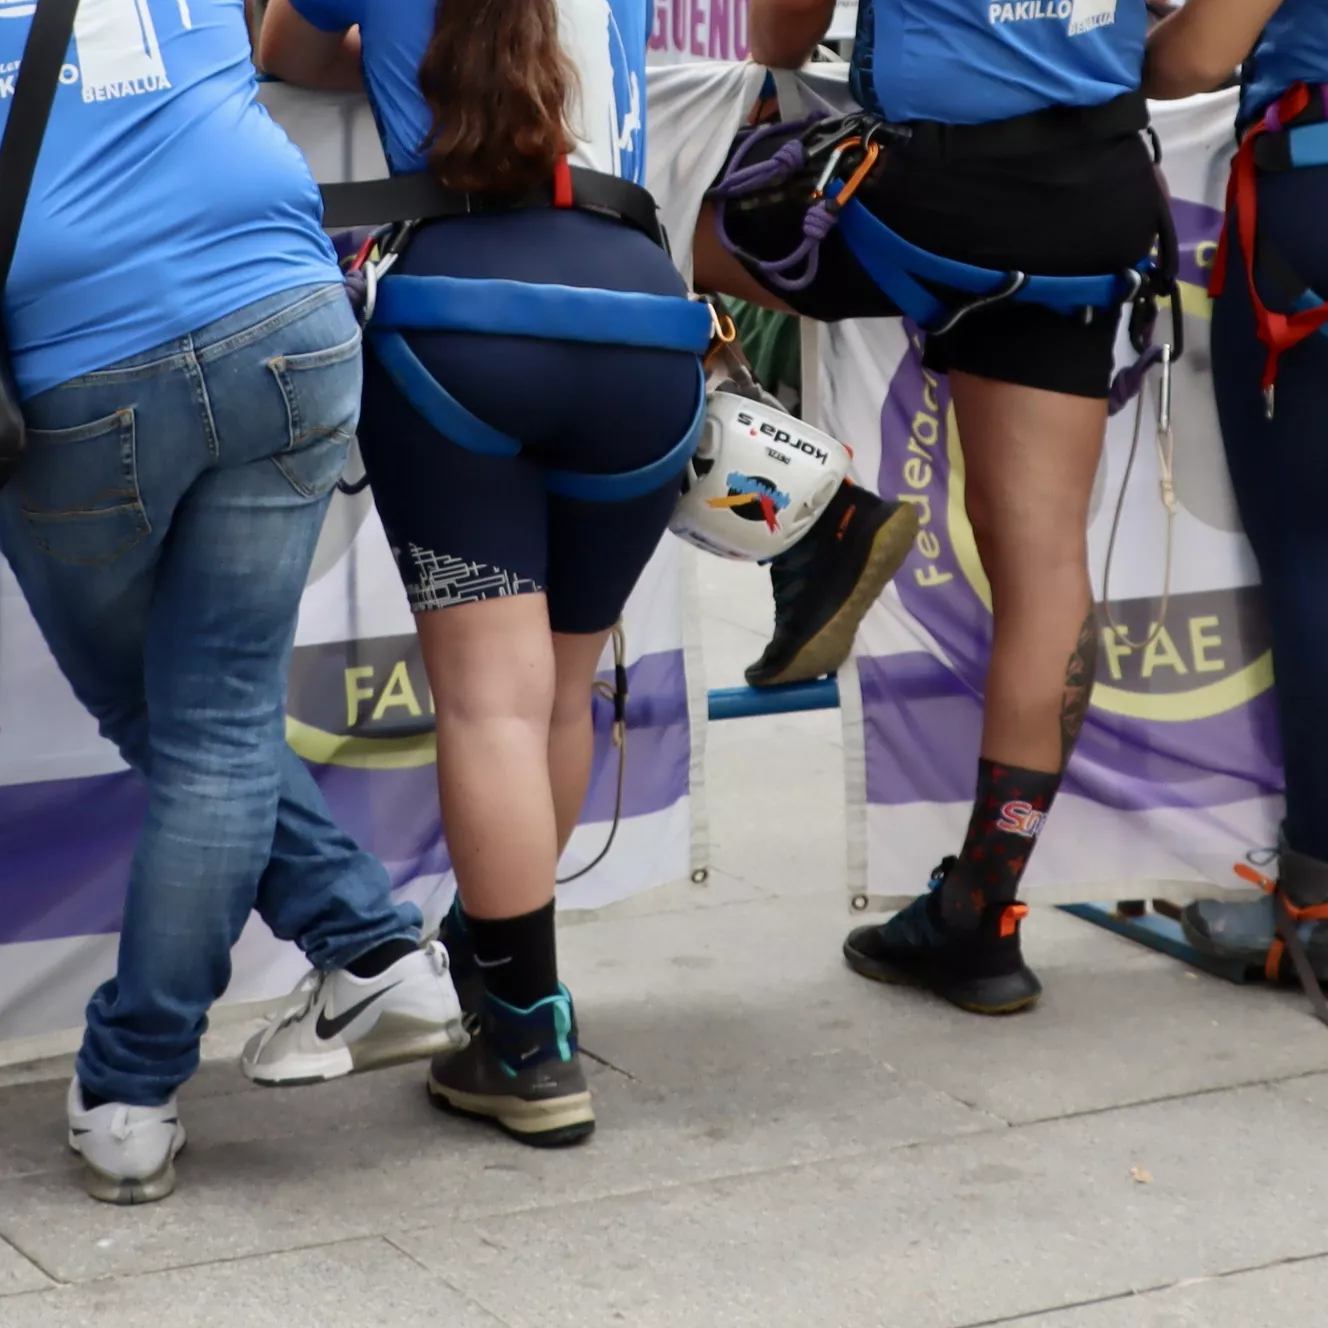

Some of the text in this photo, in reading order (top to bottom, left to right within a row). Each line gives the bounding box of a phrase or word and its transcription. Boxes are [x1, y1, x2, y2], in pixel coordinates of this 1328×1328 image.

[81, 75, 172, 104] BENALUA
[737, 412, 829, 466] korda's
[1101, 615, 1226, 681] FAE
[344, 659, 437, 728] FA
